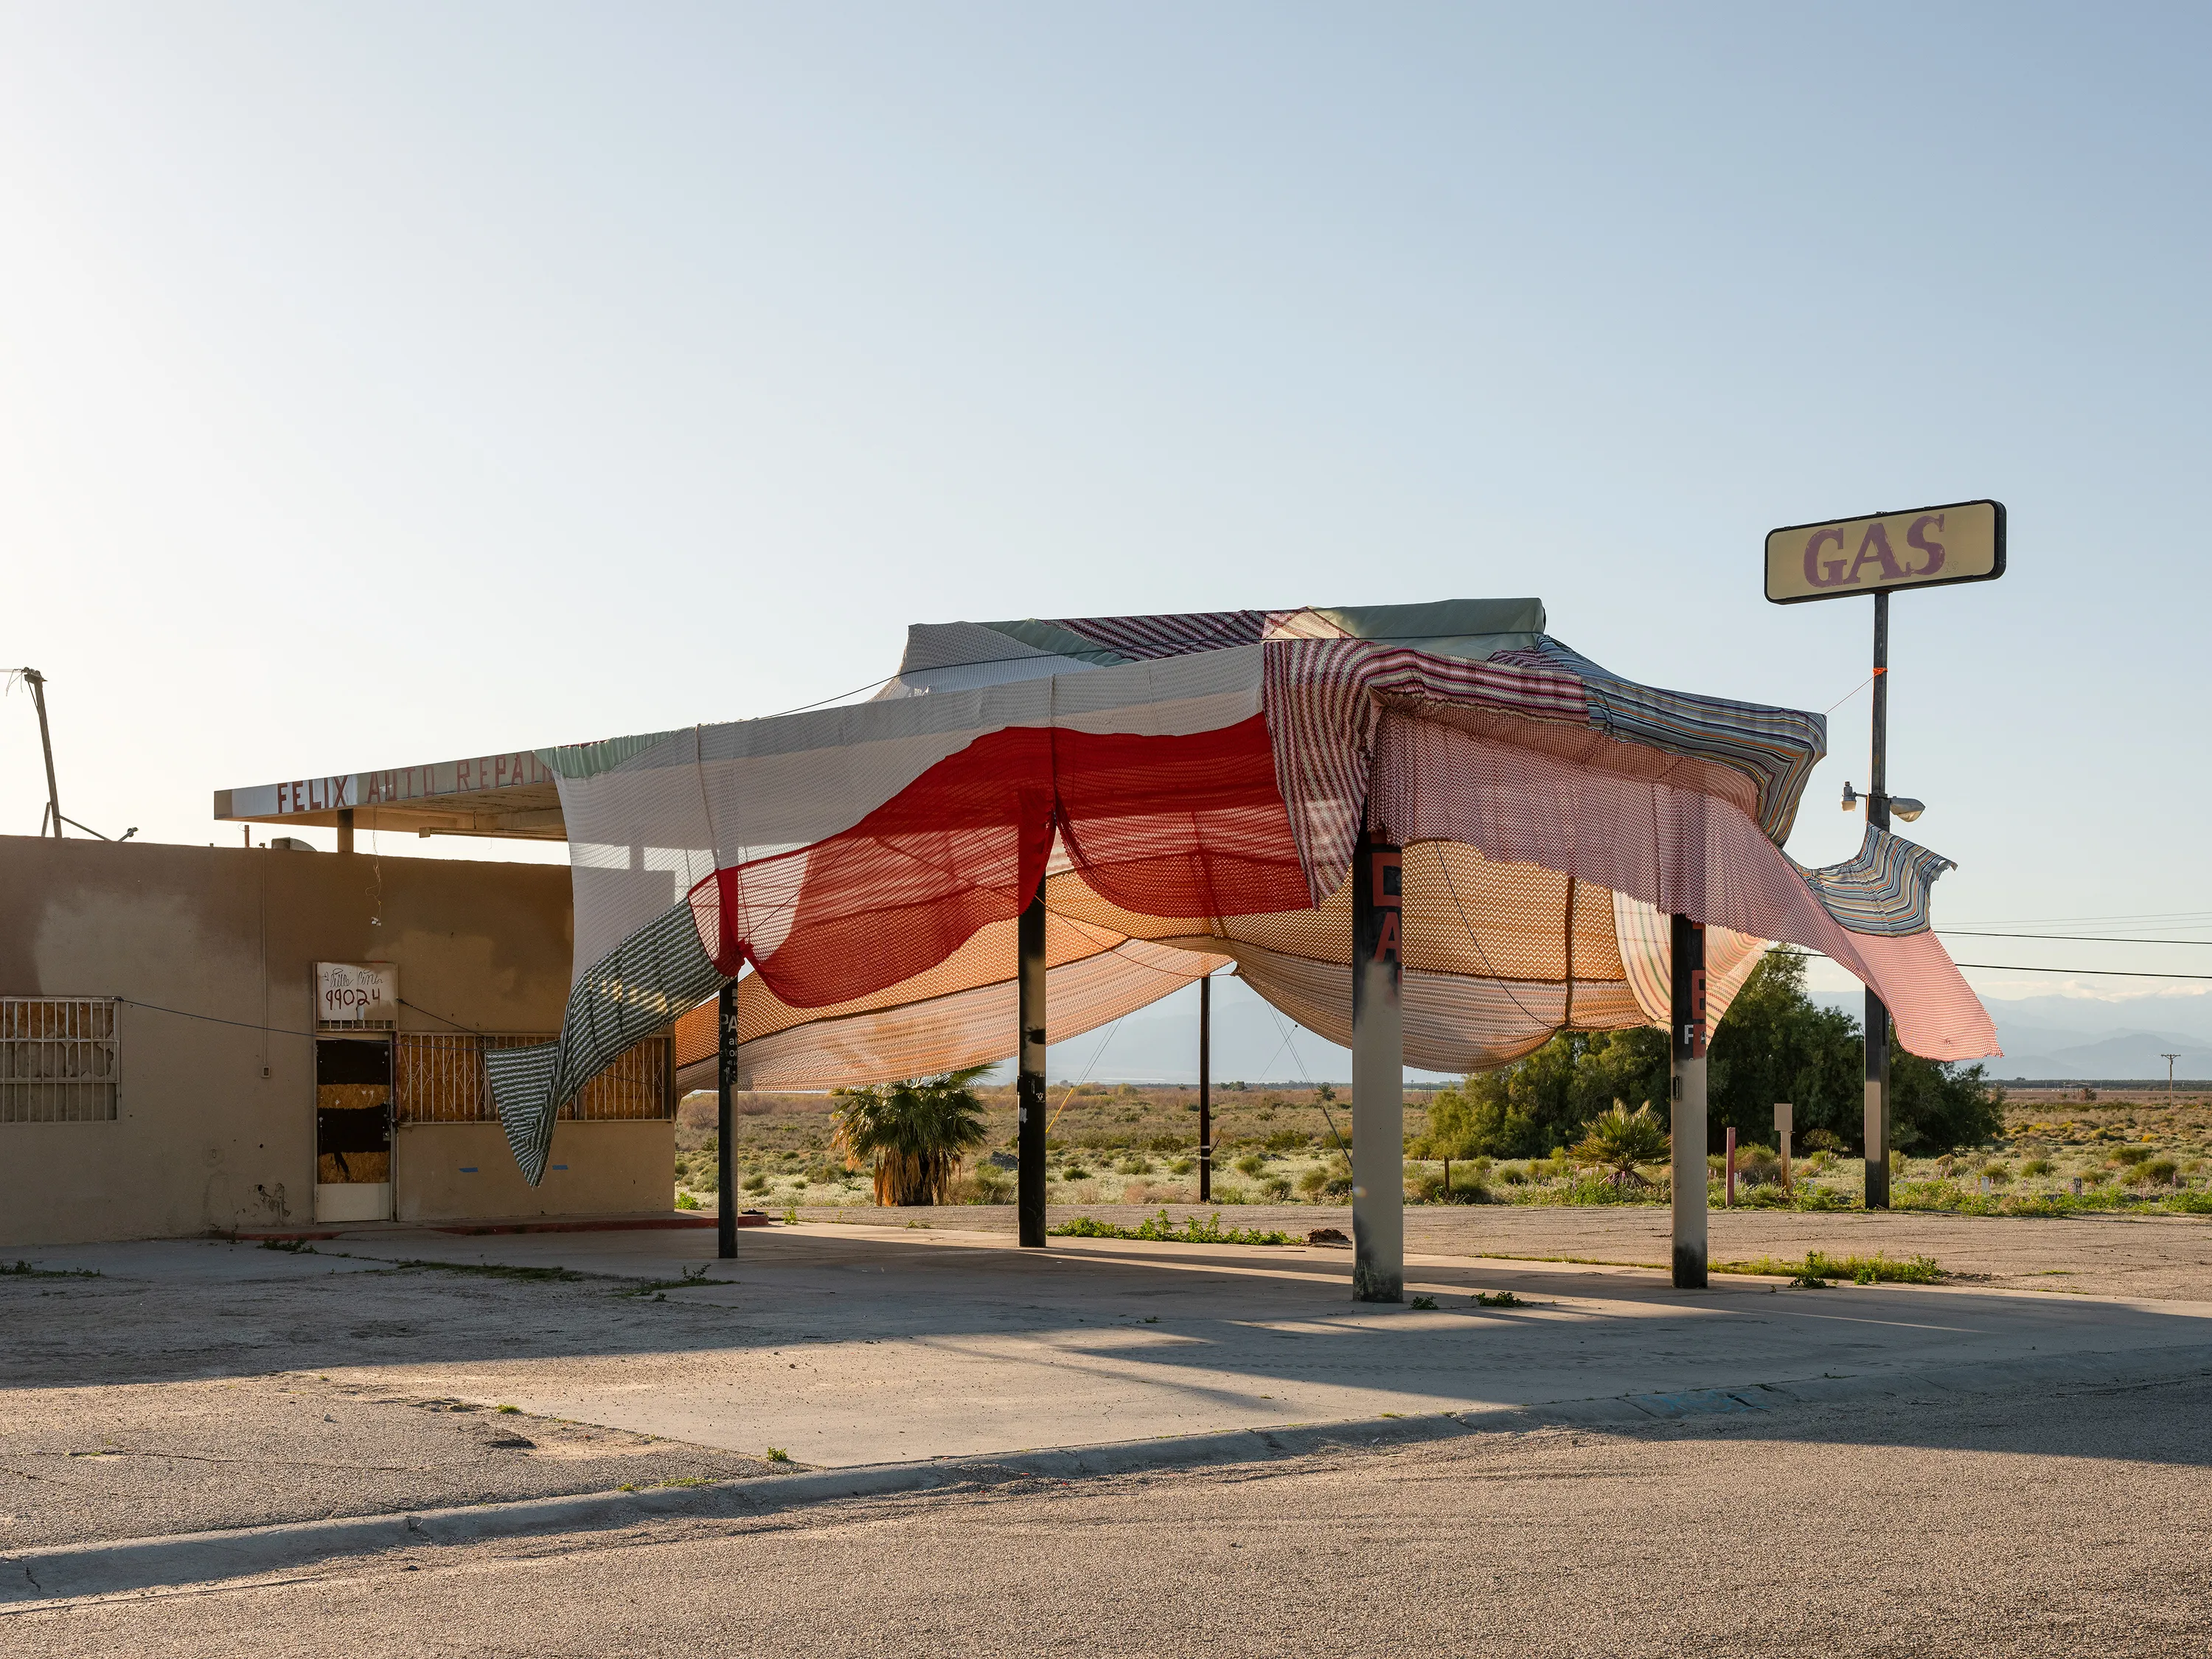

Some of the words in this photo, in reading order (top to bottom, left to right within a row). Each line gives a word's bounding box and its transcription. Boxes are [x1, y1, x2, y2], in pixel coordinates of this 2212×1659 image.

[1804, 514, 1945, 588] GAS
[277, 775, 348, 813] FELIX
[367, 765, 435, 804] AUTO
[326, 988, 381, 1010] 99024
